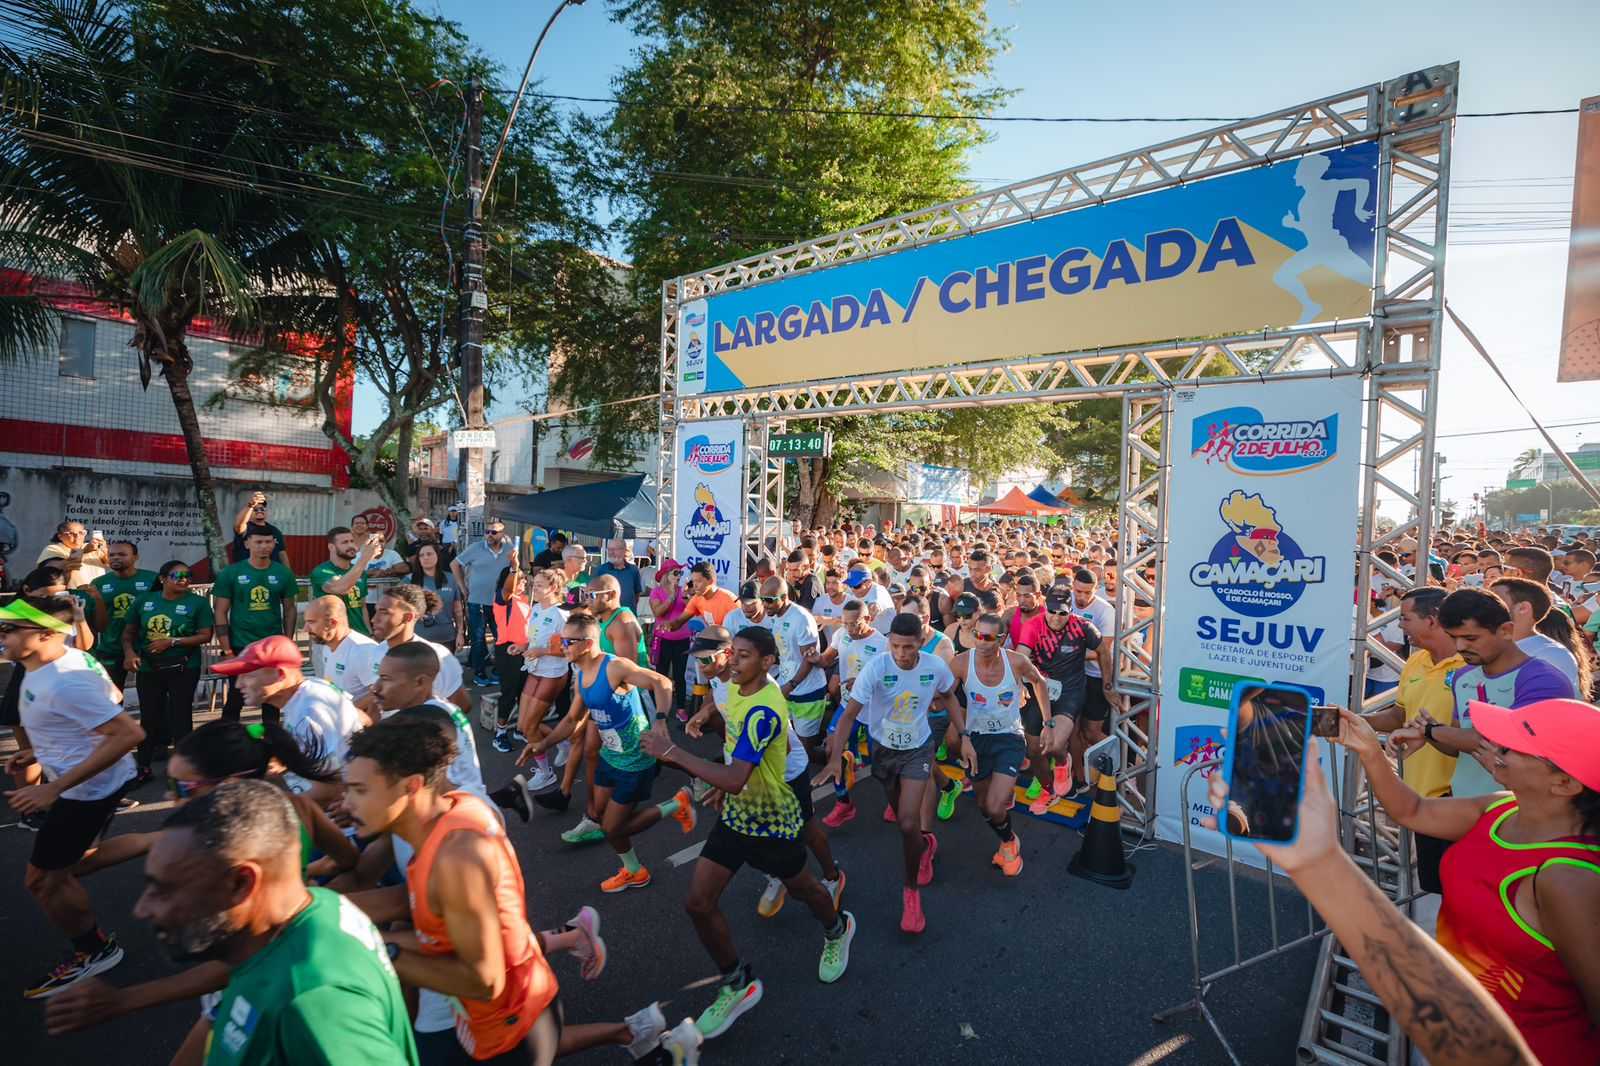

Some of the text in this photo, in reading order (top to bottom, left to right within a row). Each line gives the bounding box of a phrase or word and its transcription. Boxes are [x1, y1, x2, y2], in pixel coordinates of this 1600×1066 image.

[713, 216, 1256, 353] LARGADA / CHEGADA
[1233, 421, 1328, 440] CORRIDA
[769, 438, 822, 451] 07:13:40
[1237, 440, 1322, 457] 2 DE JULHO
[66, 504, 94, 514] Todos
[117, 507, 165, 518] orientados
[1190, 556, 1324, 589] CAMAÇARI
[1223, 588, 1258, 597] CABOCLO
[1241, 597, 1282, 607] CAMAÇARI
[1196, 615, 1325, 653] SEJUV
[1200, 642, 1316, 664] SECRETARIA DE ESPORTE
[1208, 653, 1237, 664] LAZER
[1247, 658, 1305, 673] JUVENTUDE
[1208, 686, 1233, 699] CAMA
[987, 720, 1002, 728] 91
[888, 732, 912, 744] 413
